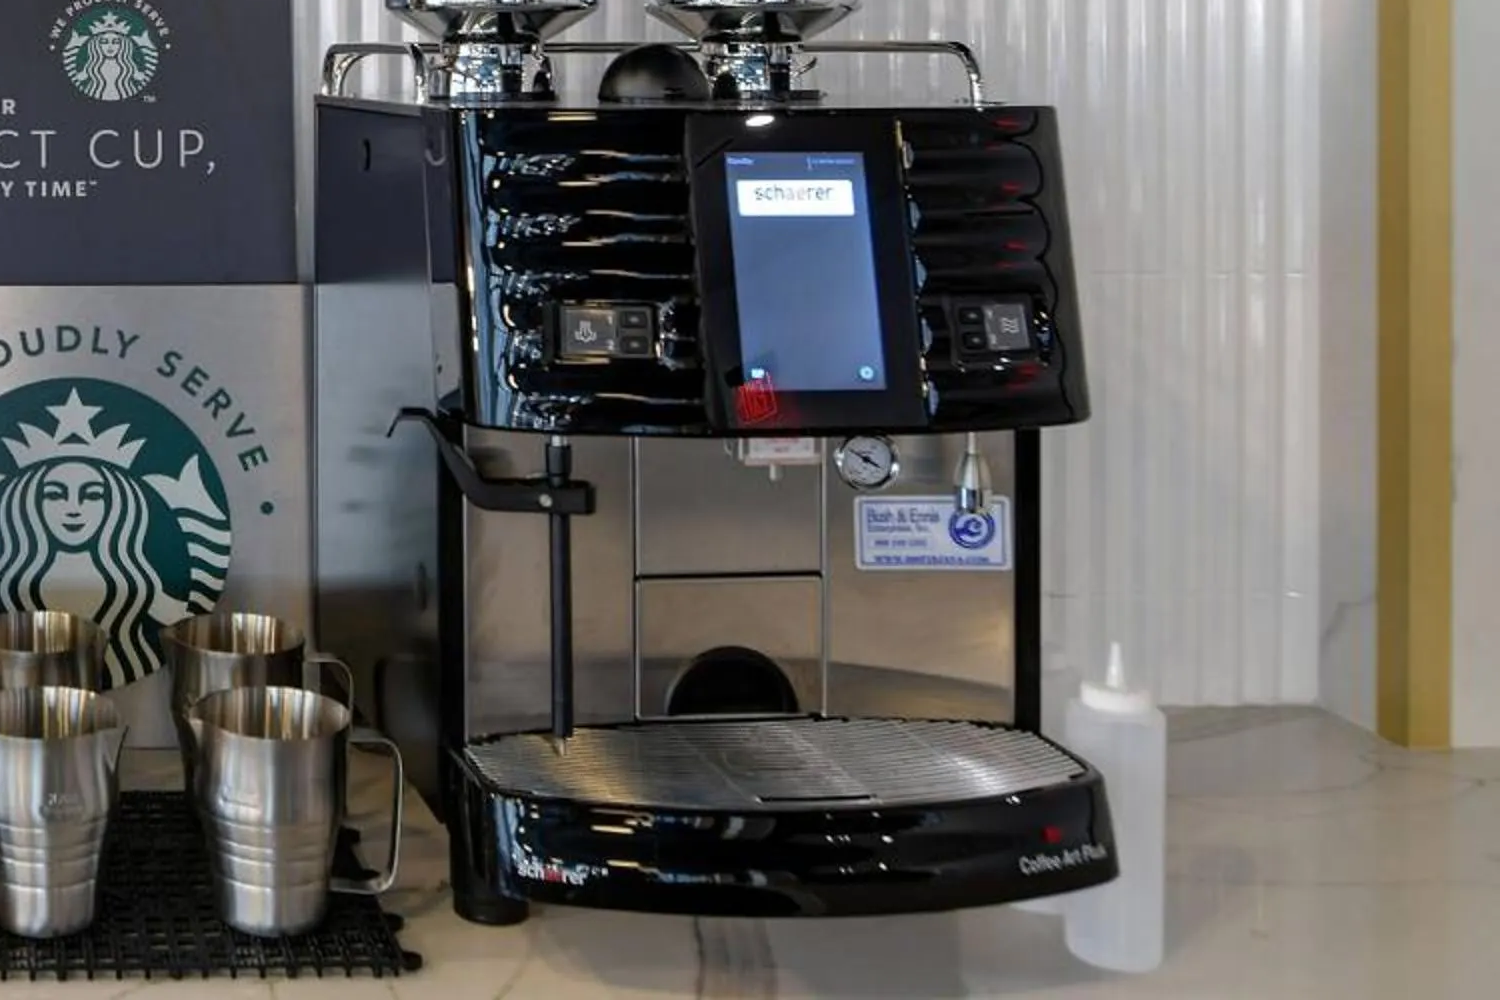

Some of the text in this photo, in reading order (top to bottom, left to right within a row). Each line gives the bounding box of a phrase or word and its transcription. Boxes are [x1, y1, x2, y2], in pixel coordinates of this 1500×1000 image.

[50, 18, 67, 39] WE
[134, 0, 170, 37] SERVE
[88, 128, 217, 175] CUP,
[753, 184, 834, 201] schaerer
[155, 349, 270, 473] SERVE
